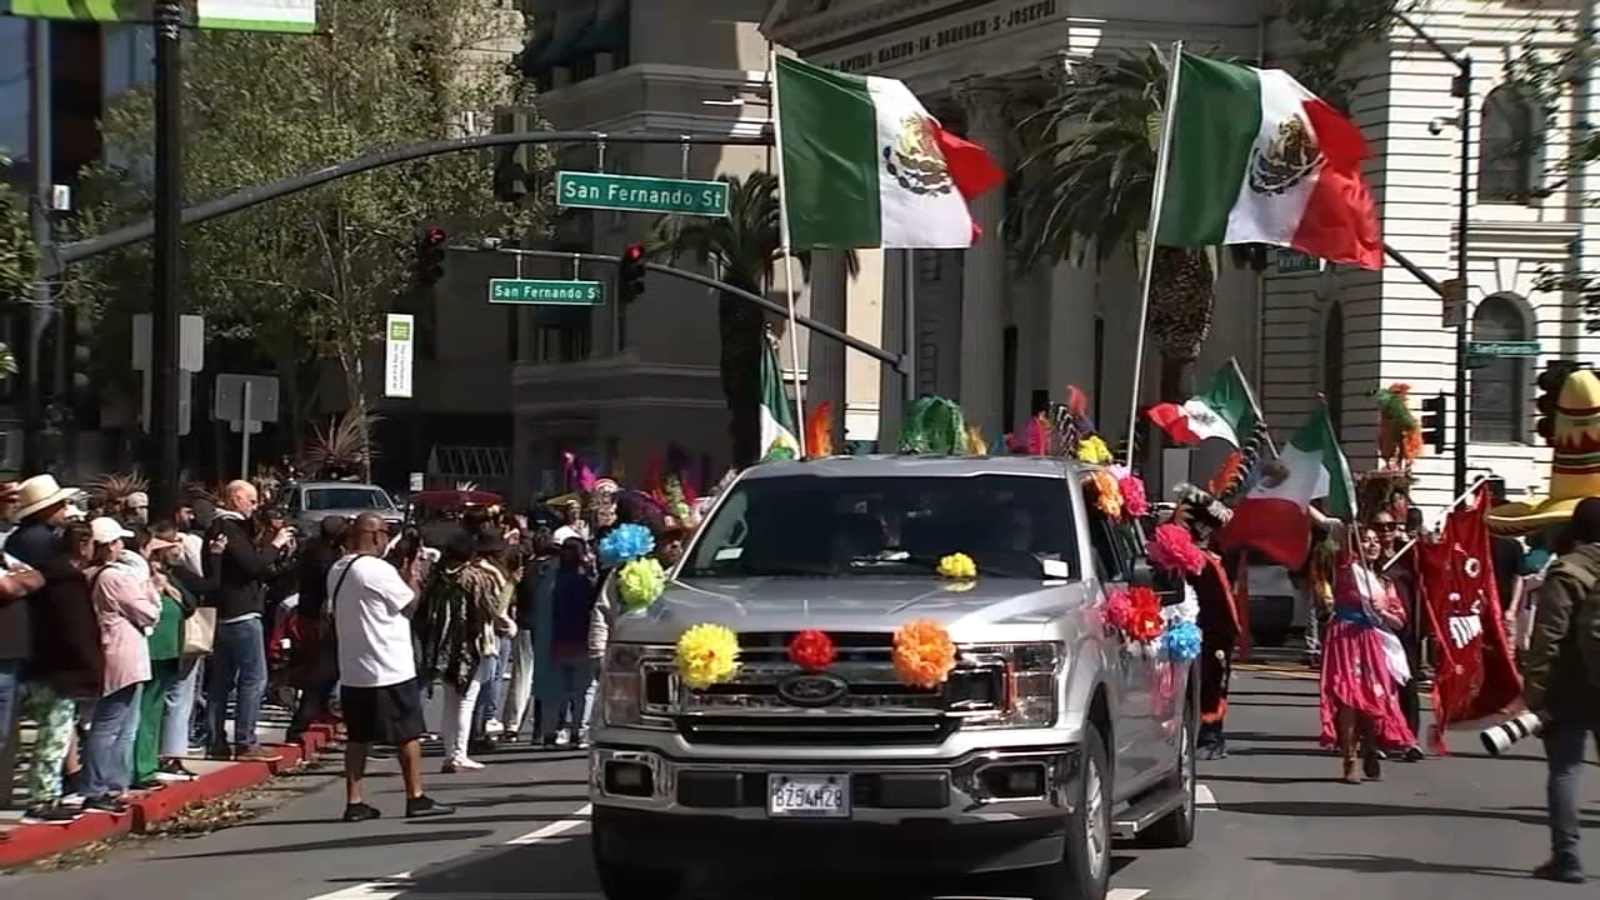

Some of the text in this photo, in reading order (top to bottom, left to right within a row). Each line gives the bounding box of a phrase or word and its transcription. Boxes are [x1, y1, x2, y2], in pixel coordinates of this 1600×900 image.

[564, 180, 721, 208] San Fernando St
[494, 284, 519, 297] San
[523, 286, 582, 299] Fernando
